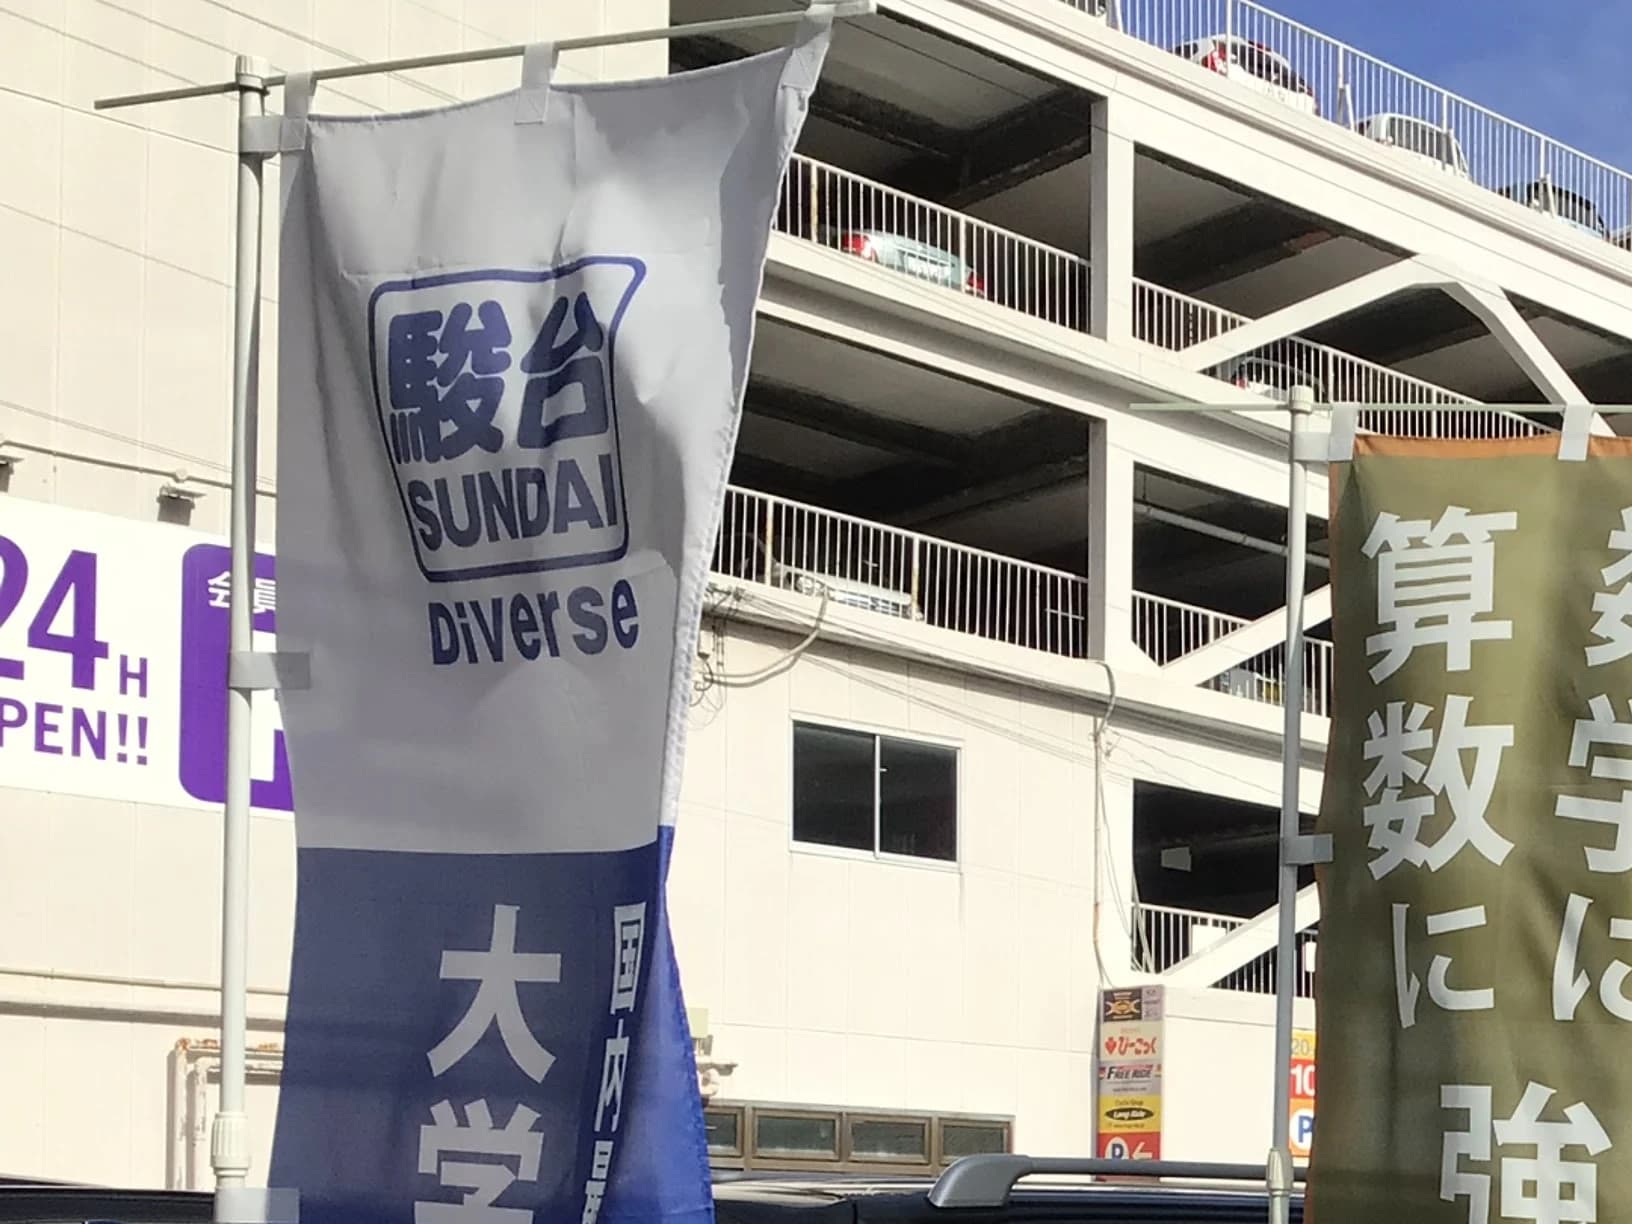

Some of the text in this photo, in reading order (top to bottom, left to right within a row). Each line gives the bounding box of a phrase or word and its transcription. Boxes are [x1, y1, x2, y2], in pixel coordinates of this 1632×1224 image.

[388, 291, 609, 464] 駿台
[407, 454, 618, 551] SUNDAI
[1361, 505, 1518, 1028] 算数に
[1298, 1115, 1315, 1144] P
